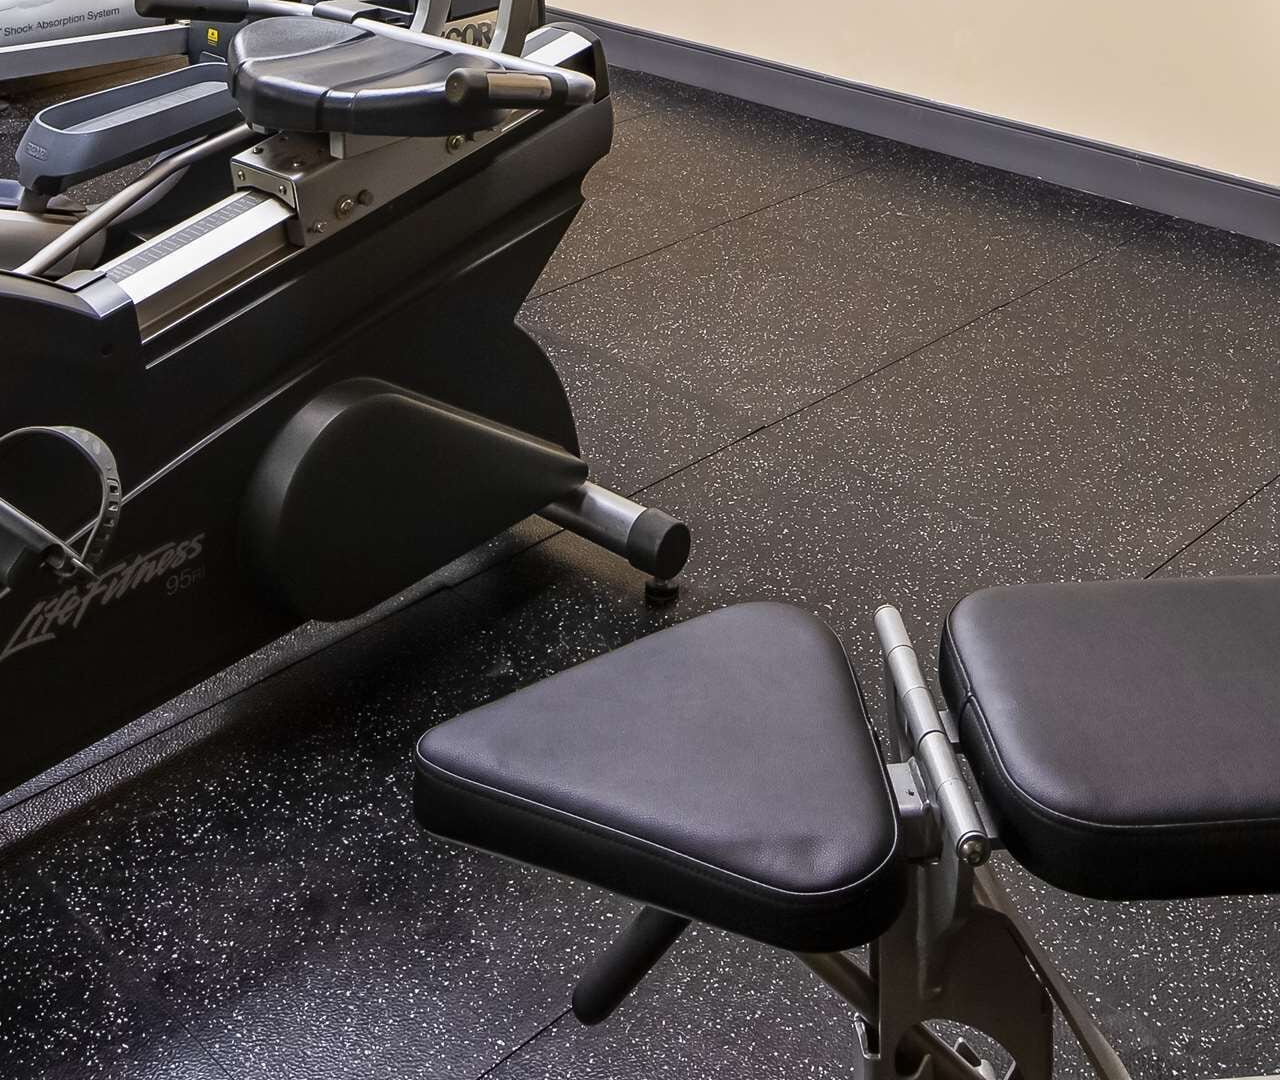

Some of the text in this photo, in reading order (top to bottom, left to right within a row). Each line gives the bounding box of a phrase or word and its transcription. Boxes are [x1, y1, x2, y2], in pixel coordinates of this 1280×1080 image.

[4, 23, 33, 37] Shock
[36, 14, 85, 30] Absorption
[87, 7, 120, 21] System
